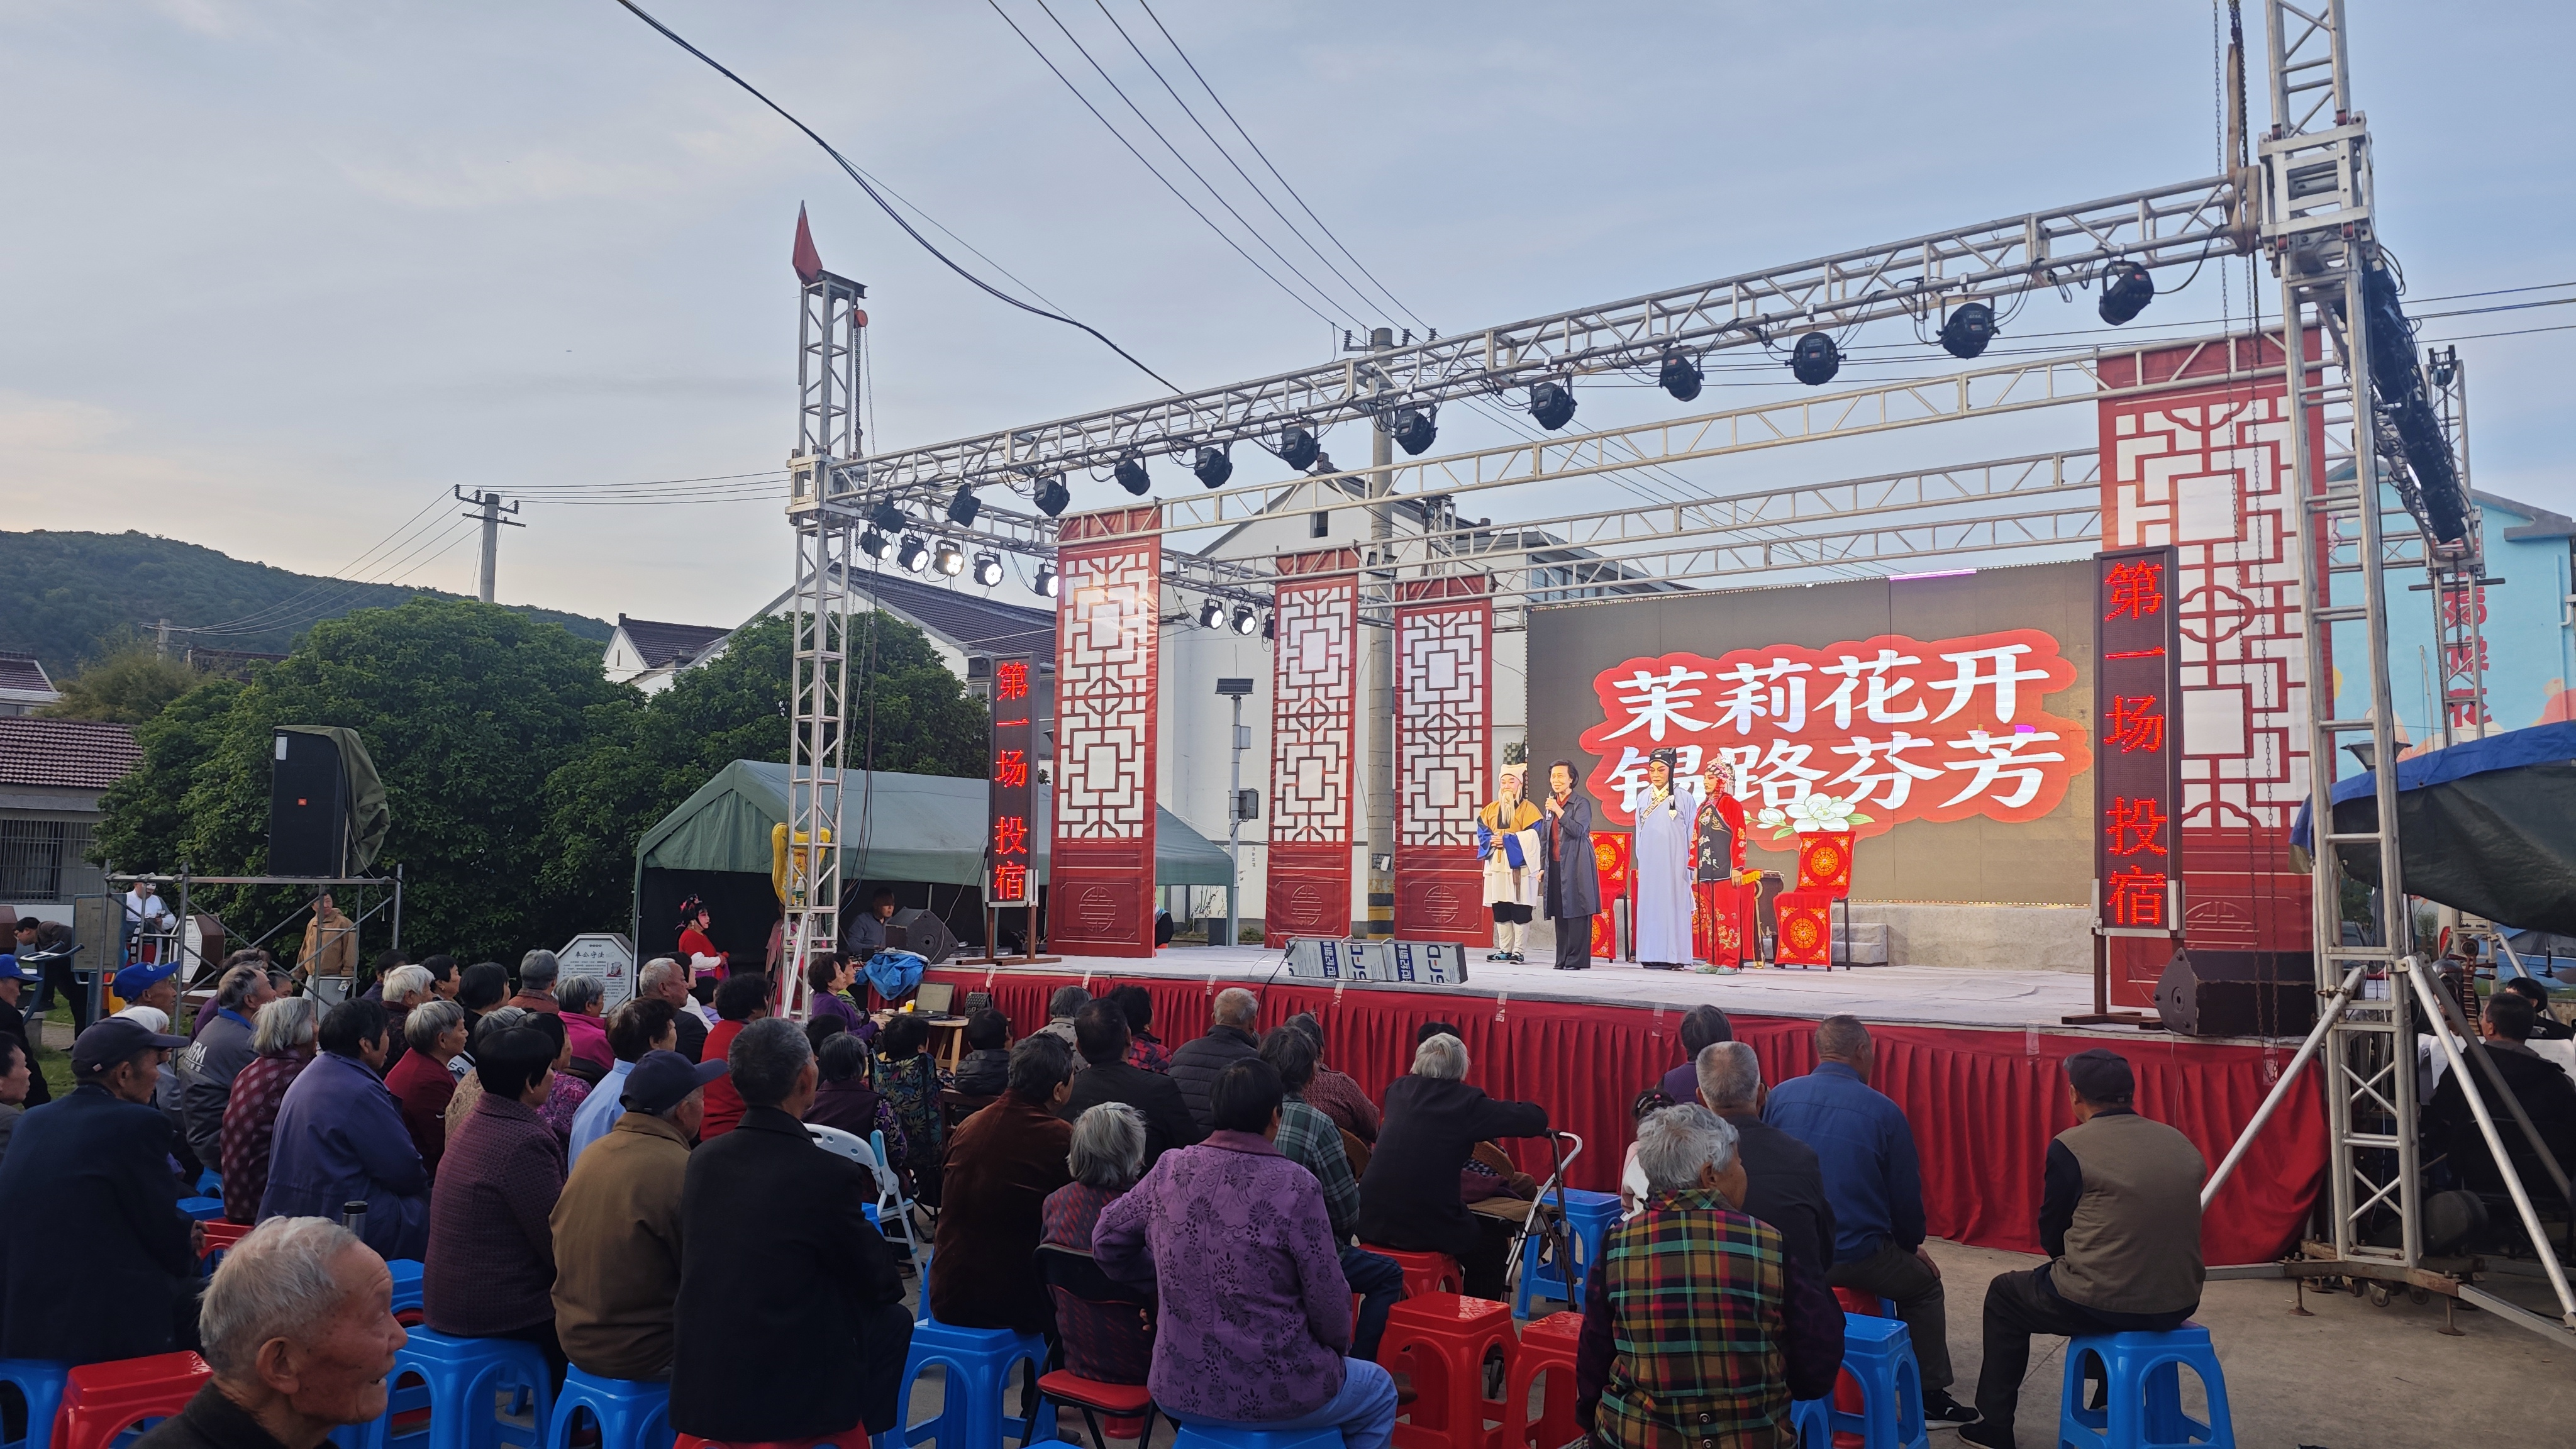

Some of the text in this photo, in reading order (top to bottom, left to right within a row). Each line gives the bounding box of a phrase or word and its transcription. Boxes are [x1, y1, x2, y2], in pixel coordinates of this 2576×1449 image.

[994, 662, 1029, 899] 第一场 投宿
[1599, 643, 2050, 741] 茉莉花开
[2104, 560, 2168, 925] 第一场 投宿
